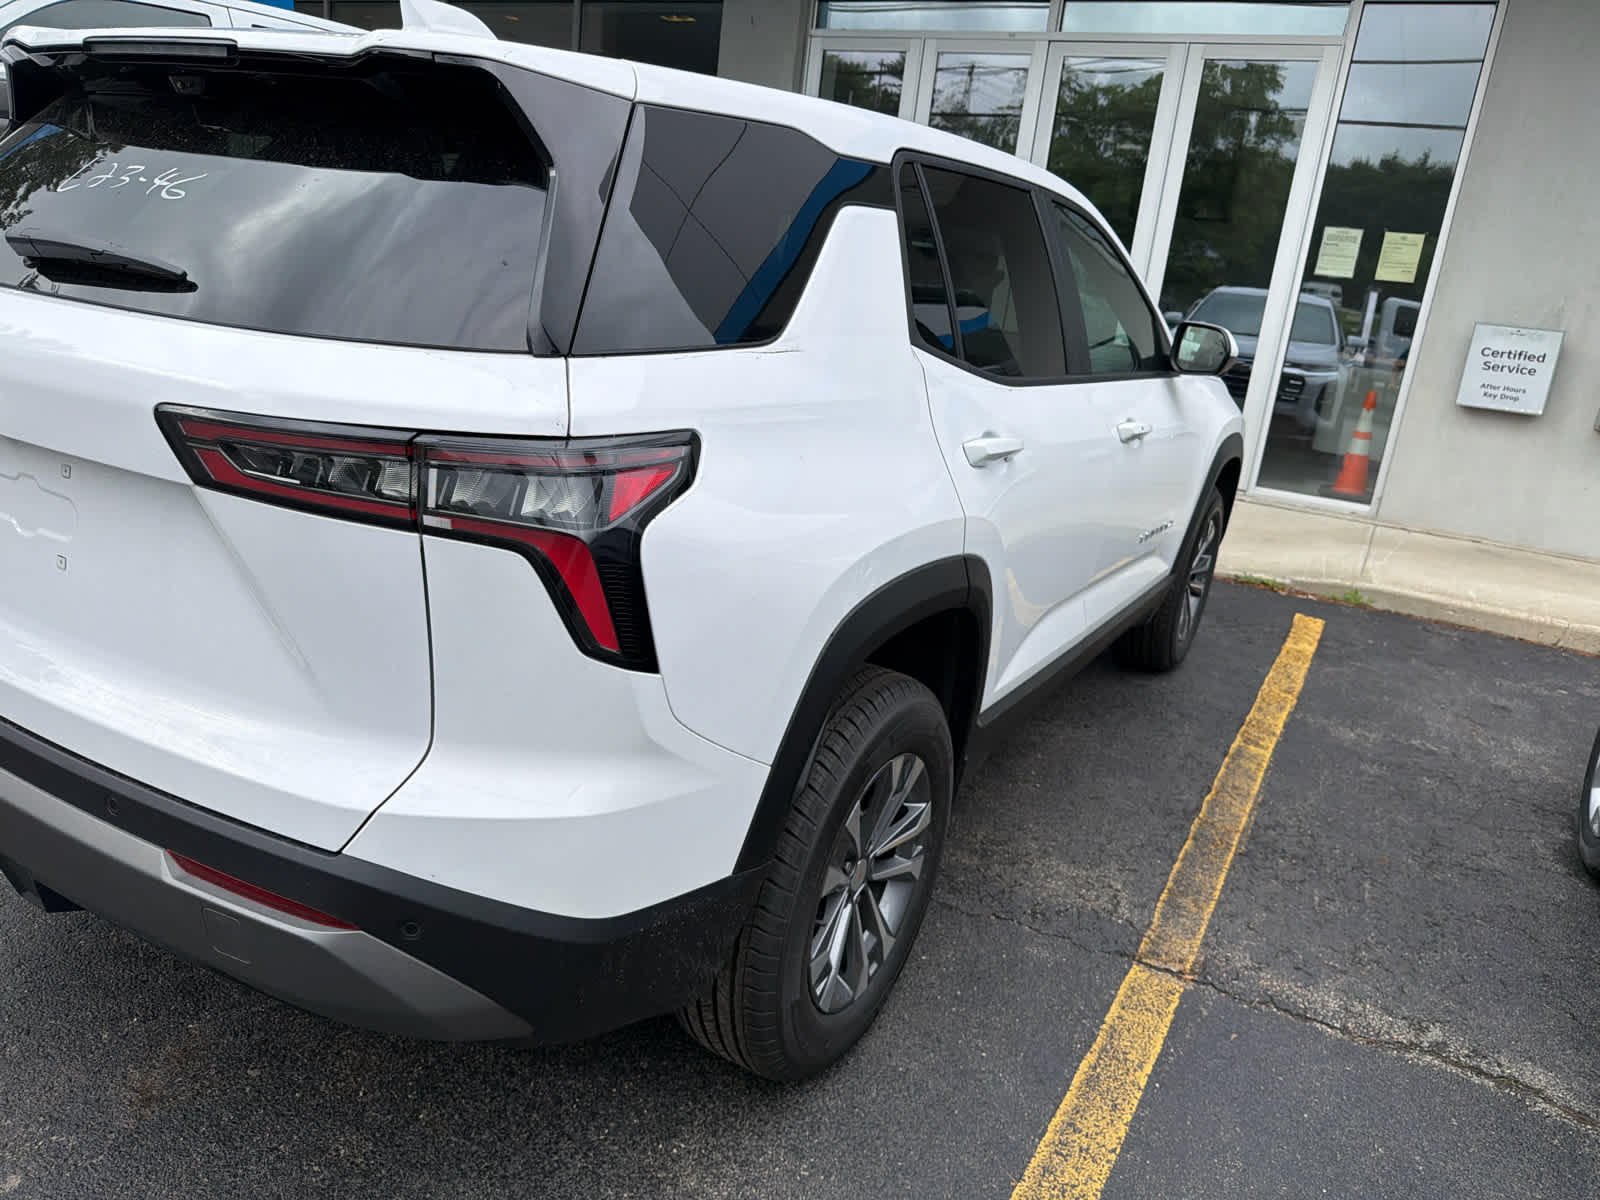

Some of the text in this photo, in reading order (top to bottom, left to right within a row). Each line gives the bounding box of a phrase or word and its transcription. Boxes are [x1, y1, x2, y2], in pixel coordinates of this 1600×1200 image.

[1480, 347, 1547, 363] Certified
[1482, 361, 1537, 376] Service
[1480, 383, 1527, 394] After Hours
[1482, 392, 1520, 402] Key Drop
